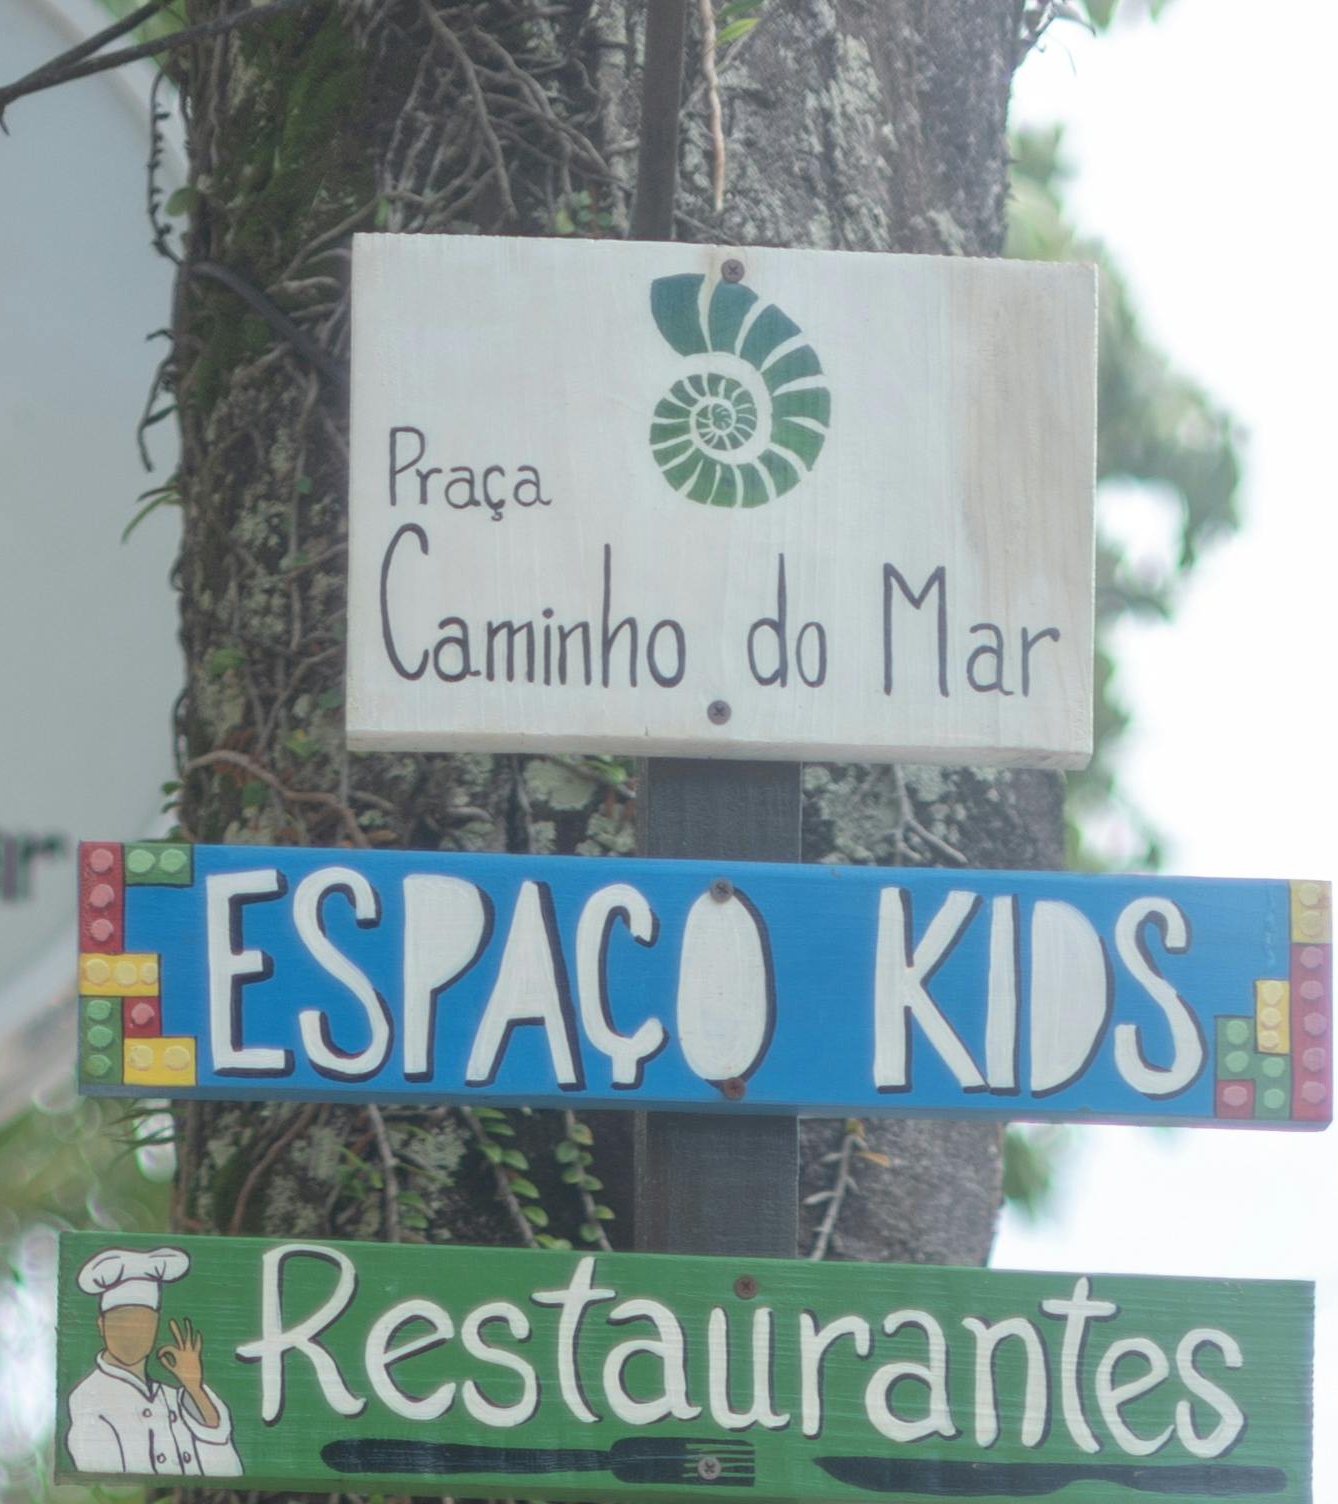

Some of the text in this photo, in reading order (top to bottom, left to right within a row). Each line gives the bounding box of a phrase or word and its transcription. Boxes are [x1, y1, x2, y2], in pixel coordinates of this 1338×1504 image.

[389, 426, 551, 521] Praça
[380, 523, 1061, 697] Caminho do Mar
[205, 866, 1207, 1098] ESPAÇO KIDS
[237, 1243, 1245, 1461] Restaurantes
